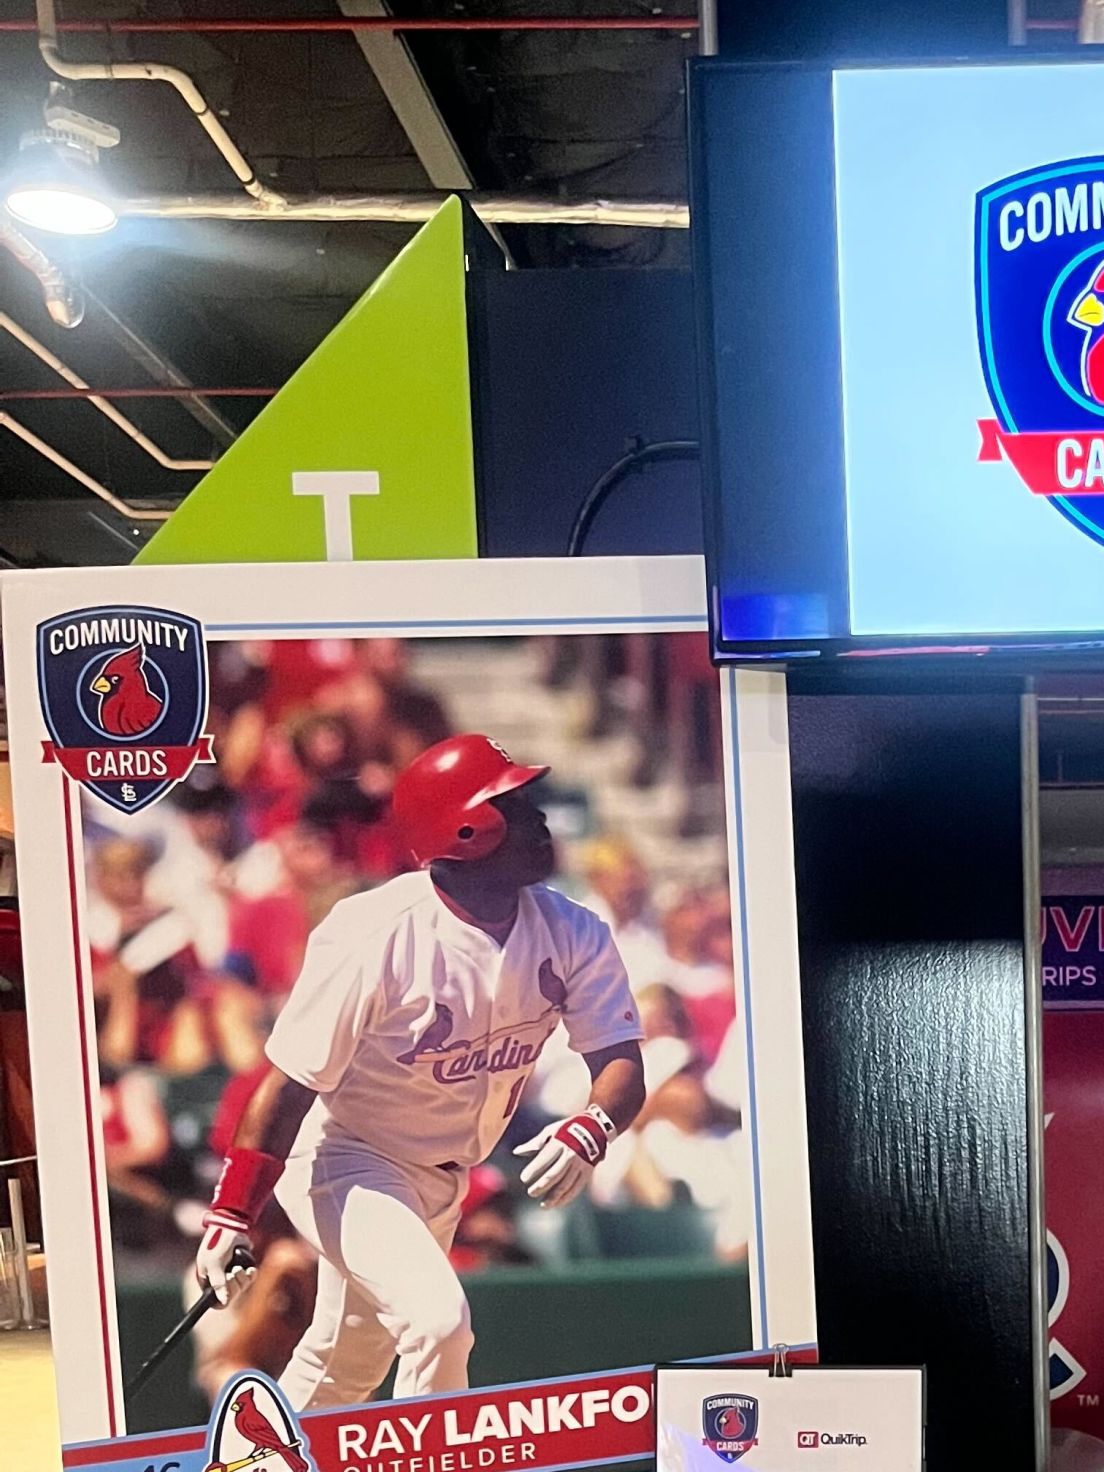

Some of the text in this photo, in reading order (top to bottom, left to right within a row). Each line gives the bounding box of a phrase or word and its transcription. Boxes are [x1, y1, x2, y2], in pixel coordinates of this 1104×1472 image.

[49, 618, 189, 655] COMMUNITY
[86, 749, 168, 777] CARDS
[706, 1396, 755, 1411] COMMUNITY
[1077, 1394, 1100, 1407] TM
[336, 1382, 654, 1463] RAY LANKFO
[716, 1441, 745, 1452] CARDS
[799, 1432, 867, 1447] QT QuikTrip
